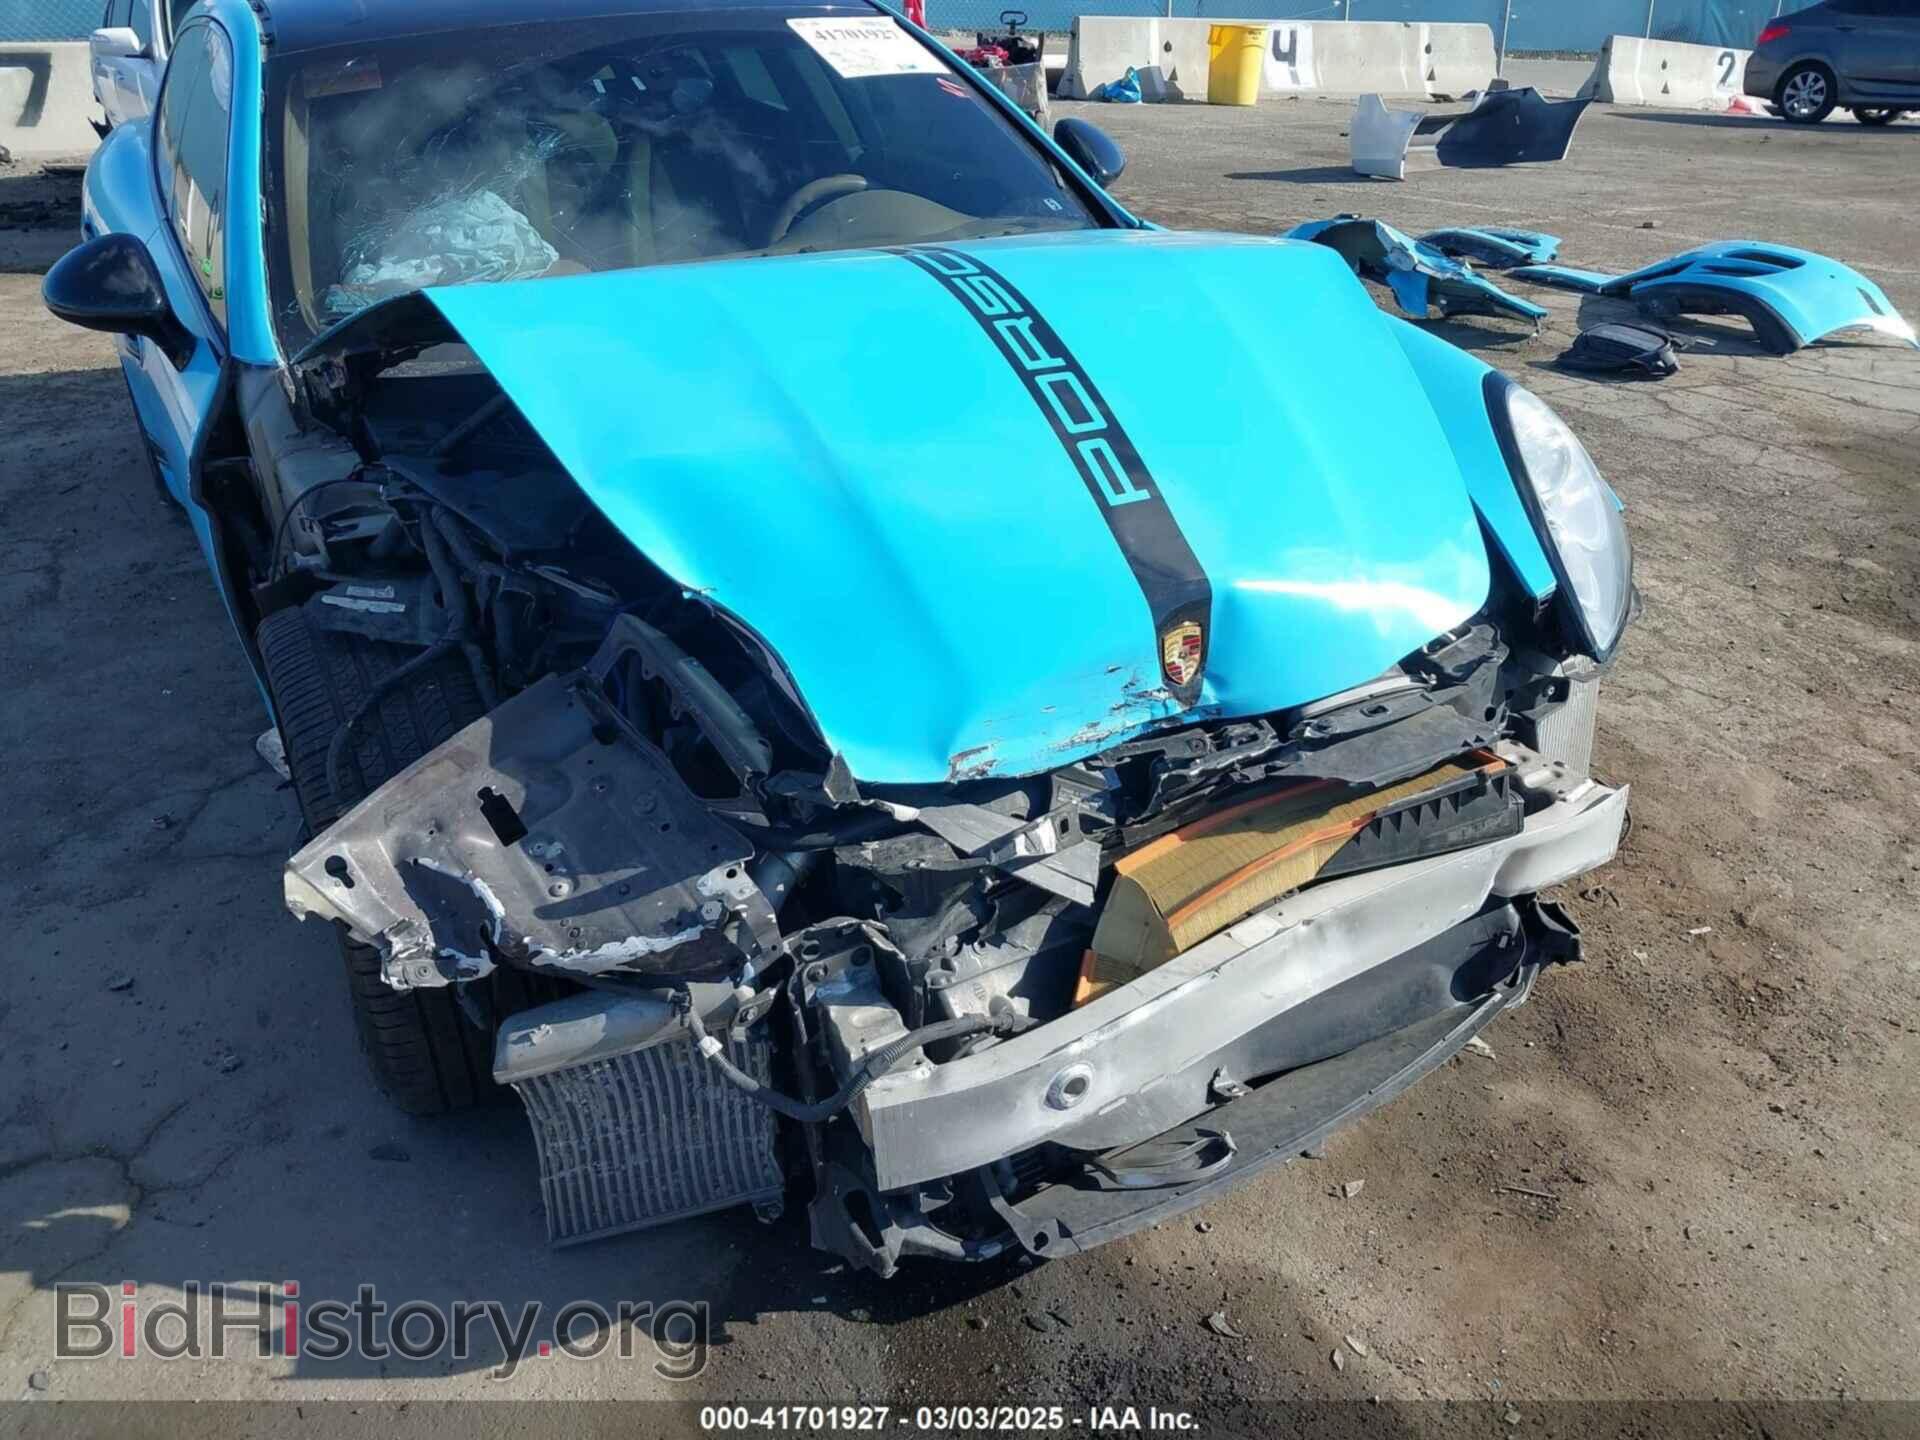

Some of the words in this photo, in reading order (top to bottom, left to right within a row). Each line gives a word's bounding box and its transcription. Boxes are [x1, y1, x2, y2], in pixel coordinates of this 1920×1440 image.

[814, 29, 899, 42] 41701927
[1271, 29, 1300, 85] 4
[1717, 51, 1737, 88] 2
[908, 250, 1151, 507] PORSC
